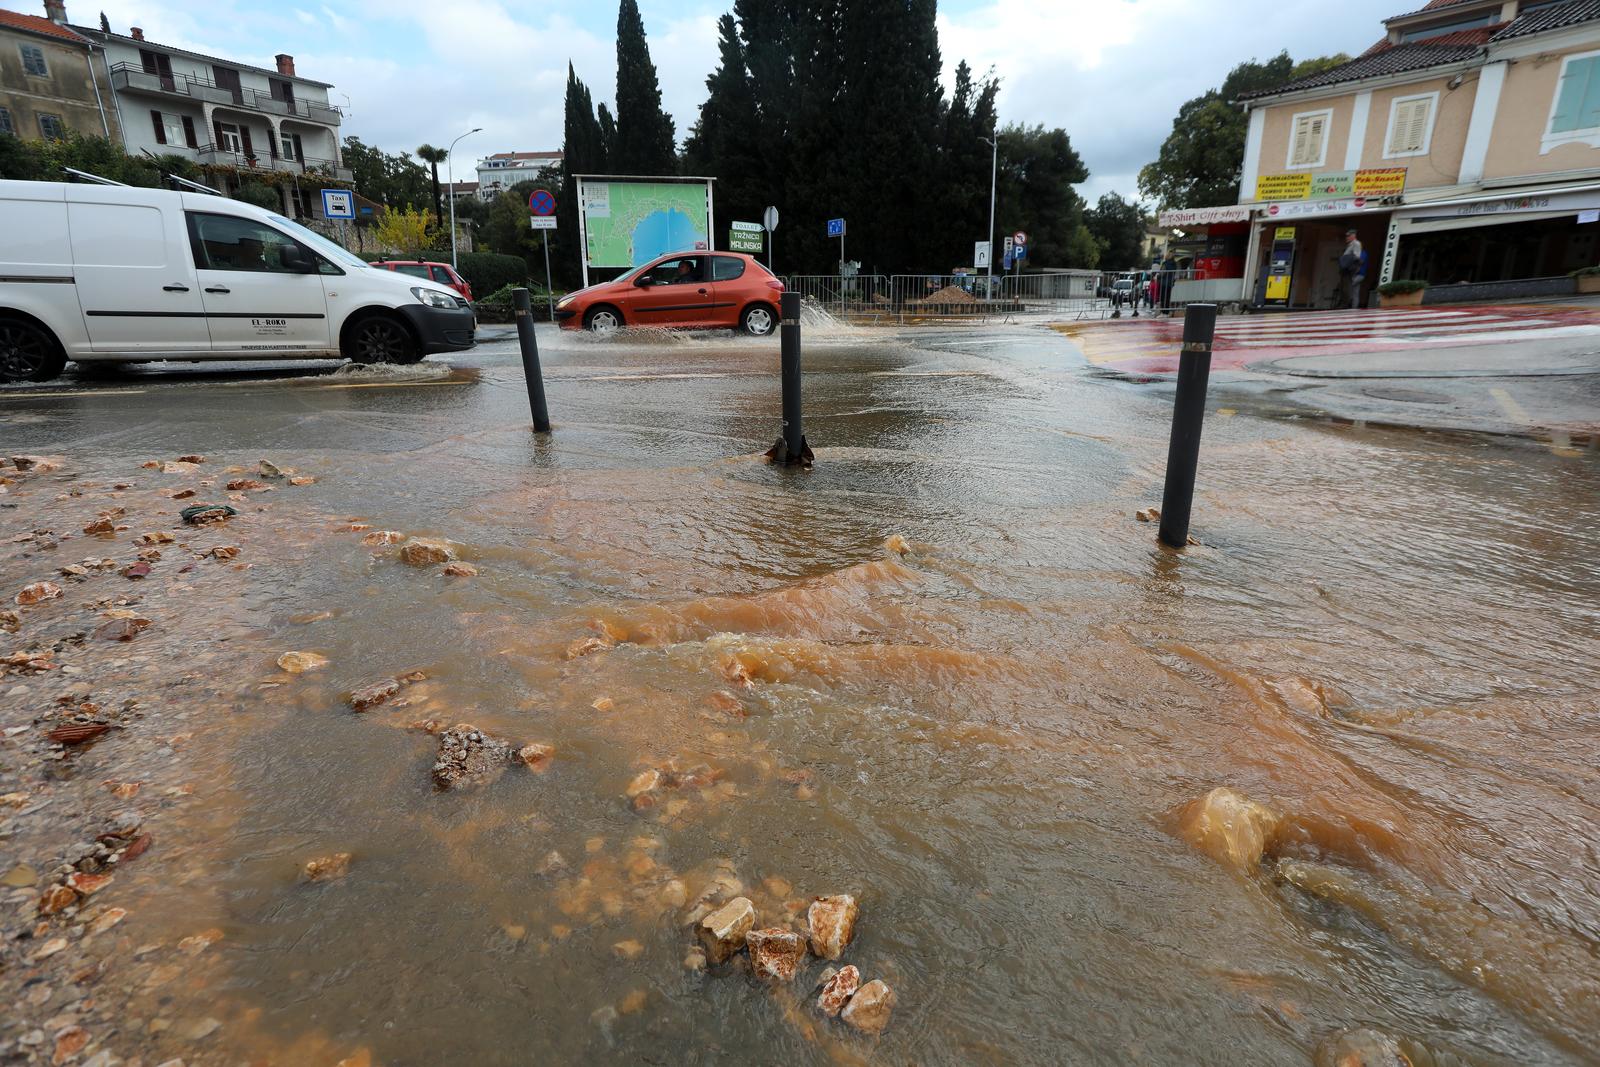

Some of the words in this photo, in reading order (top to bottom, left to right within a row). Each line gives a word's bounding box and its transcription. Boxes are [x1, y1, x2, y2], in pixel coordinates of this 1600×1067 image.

[1167, 213, 1196, 222] T-Shirt
[1200, 211, 1218, 220] Gift
[1221, 209, 1245, 220] shop
[734, 231, 760, 240] TRŽNICA
[730, 241, 762, 250] MALINSKA
[1015, 246, 1024, 258] P
[1381, 224, 1397, 283] TOBACCO
